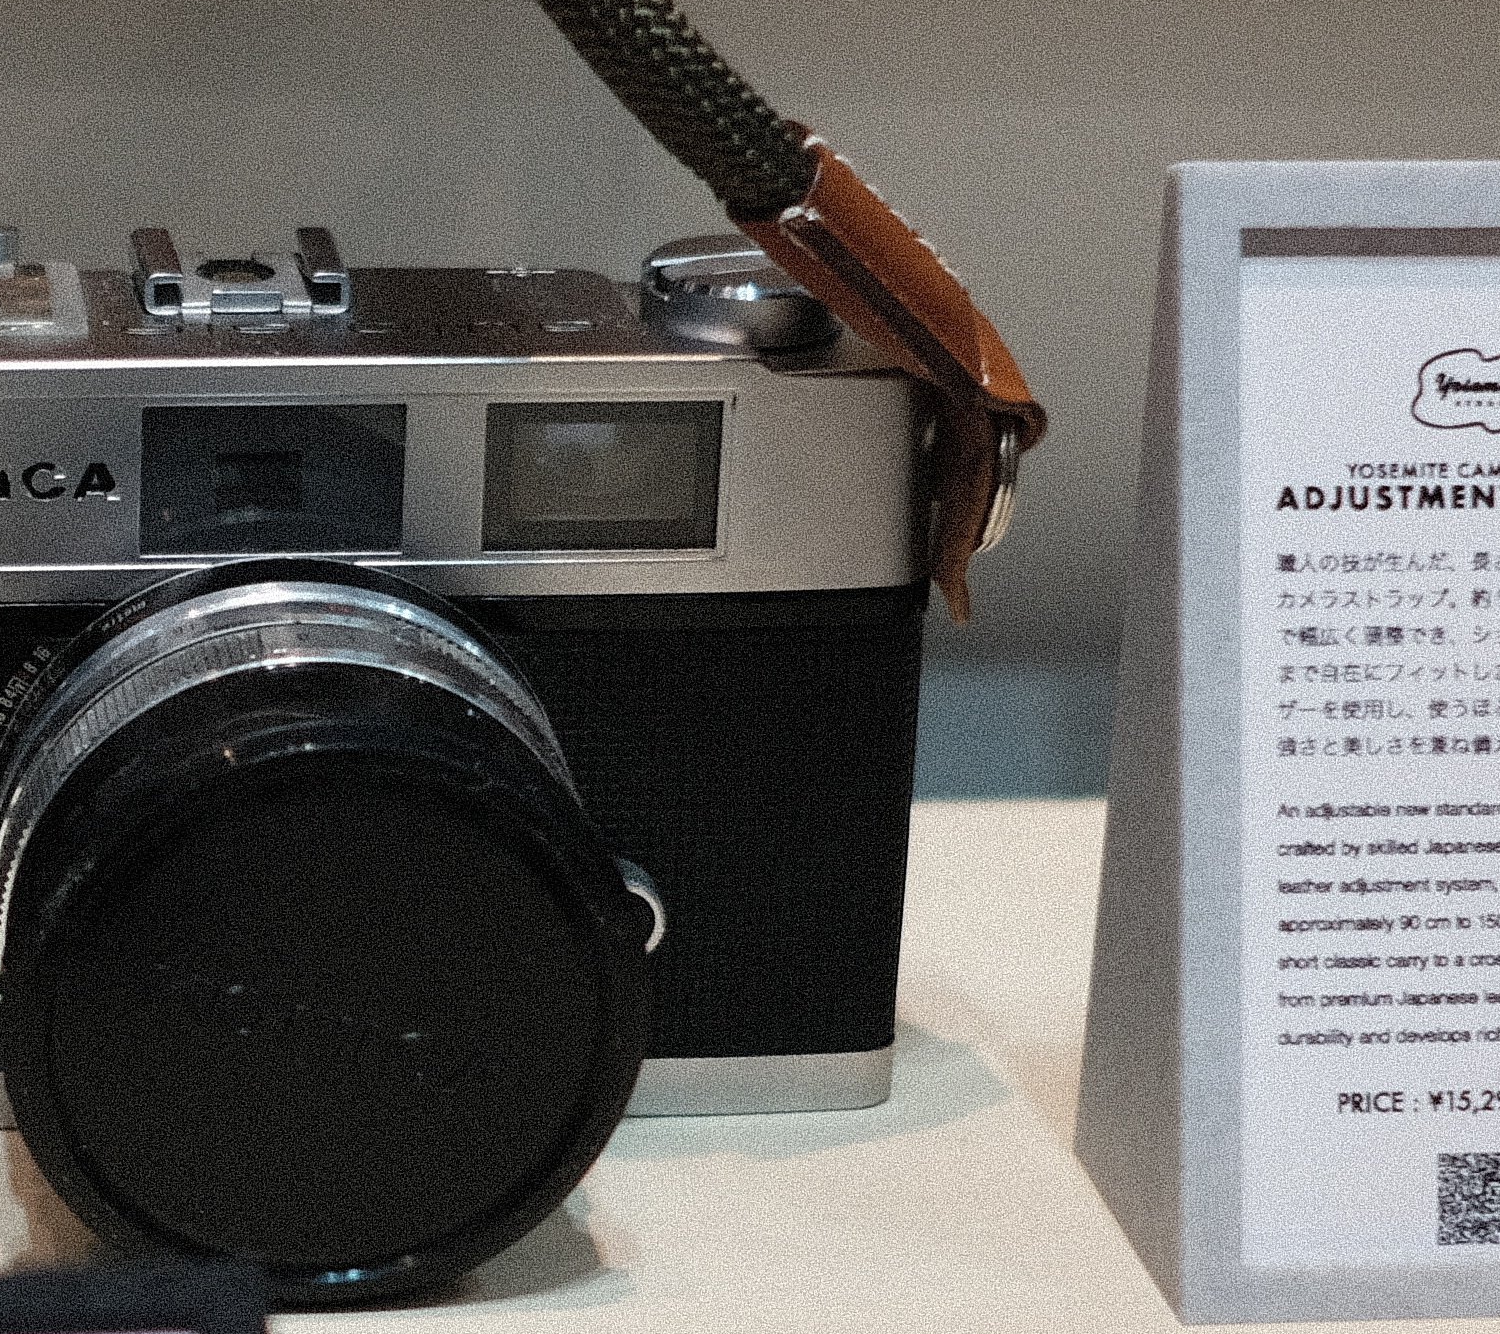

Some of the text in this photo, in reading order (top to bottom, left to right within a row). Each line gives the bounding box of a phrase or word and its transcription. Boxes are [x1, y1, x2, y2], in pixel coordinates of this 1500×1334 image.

[1347, 461, 1450, 481] YOSEMITE
[1278, 803, 1302, 820] An
[1305, 803, 1393, 823] adjustable
[1395, 804, 1433, 818] new
[1277, 840, 1338, 858] crafted
[1342, 841, 1364, 861] by
[1367, 839, 1421, 858] skilled
[1278, 879, 1335, 896] leather
[1339, 877, 1432, 898] adjustment
[1278, 916, 1397, 936] approximately
[1399, 915, 1423, 933] 90
[1425, 917, 1453, 932] cm
[1456, 915, 1473, 932] to
[1278, 955, 1320, 972] short
[1324, 954, 1383, 972] classic
[1386, 956, 1431, 974] carry
[1433, 954, 1451, 969] to
[1454, 955, 1466, 969] a
[1278, 992, 1317, 1009] from
[1320, 992, 1395, 1011] premium
[1396, 991, 1481, 1010] Japanese
[1278, 1029, 1355, 1050] durability
[1359, 1029, 1393, 1046] and
[1396, 1028, 1473, 1047] develops
[1338, 1091, 1406, 1115] PRICE
